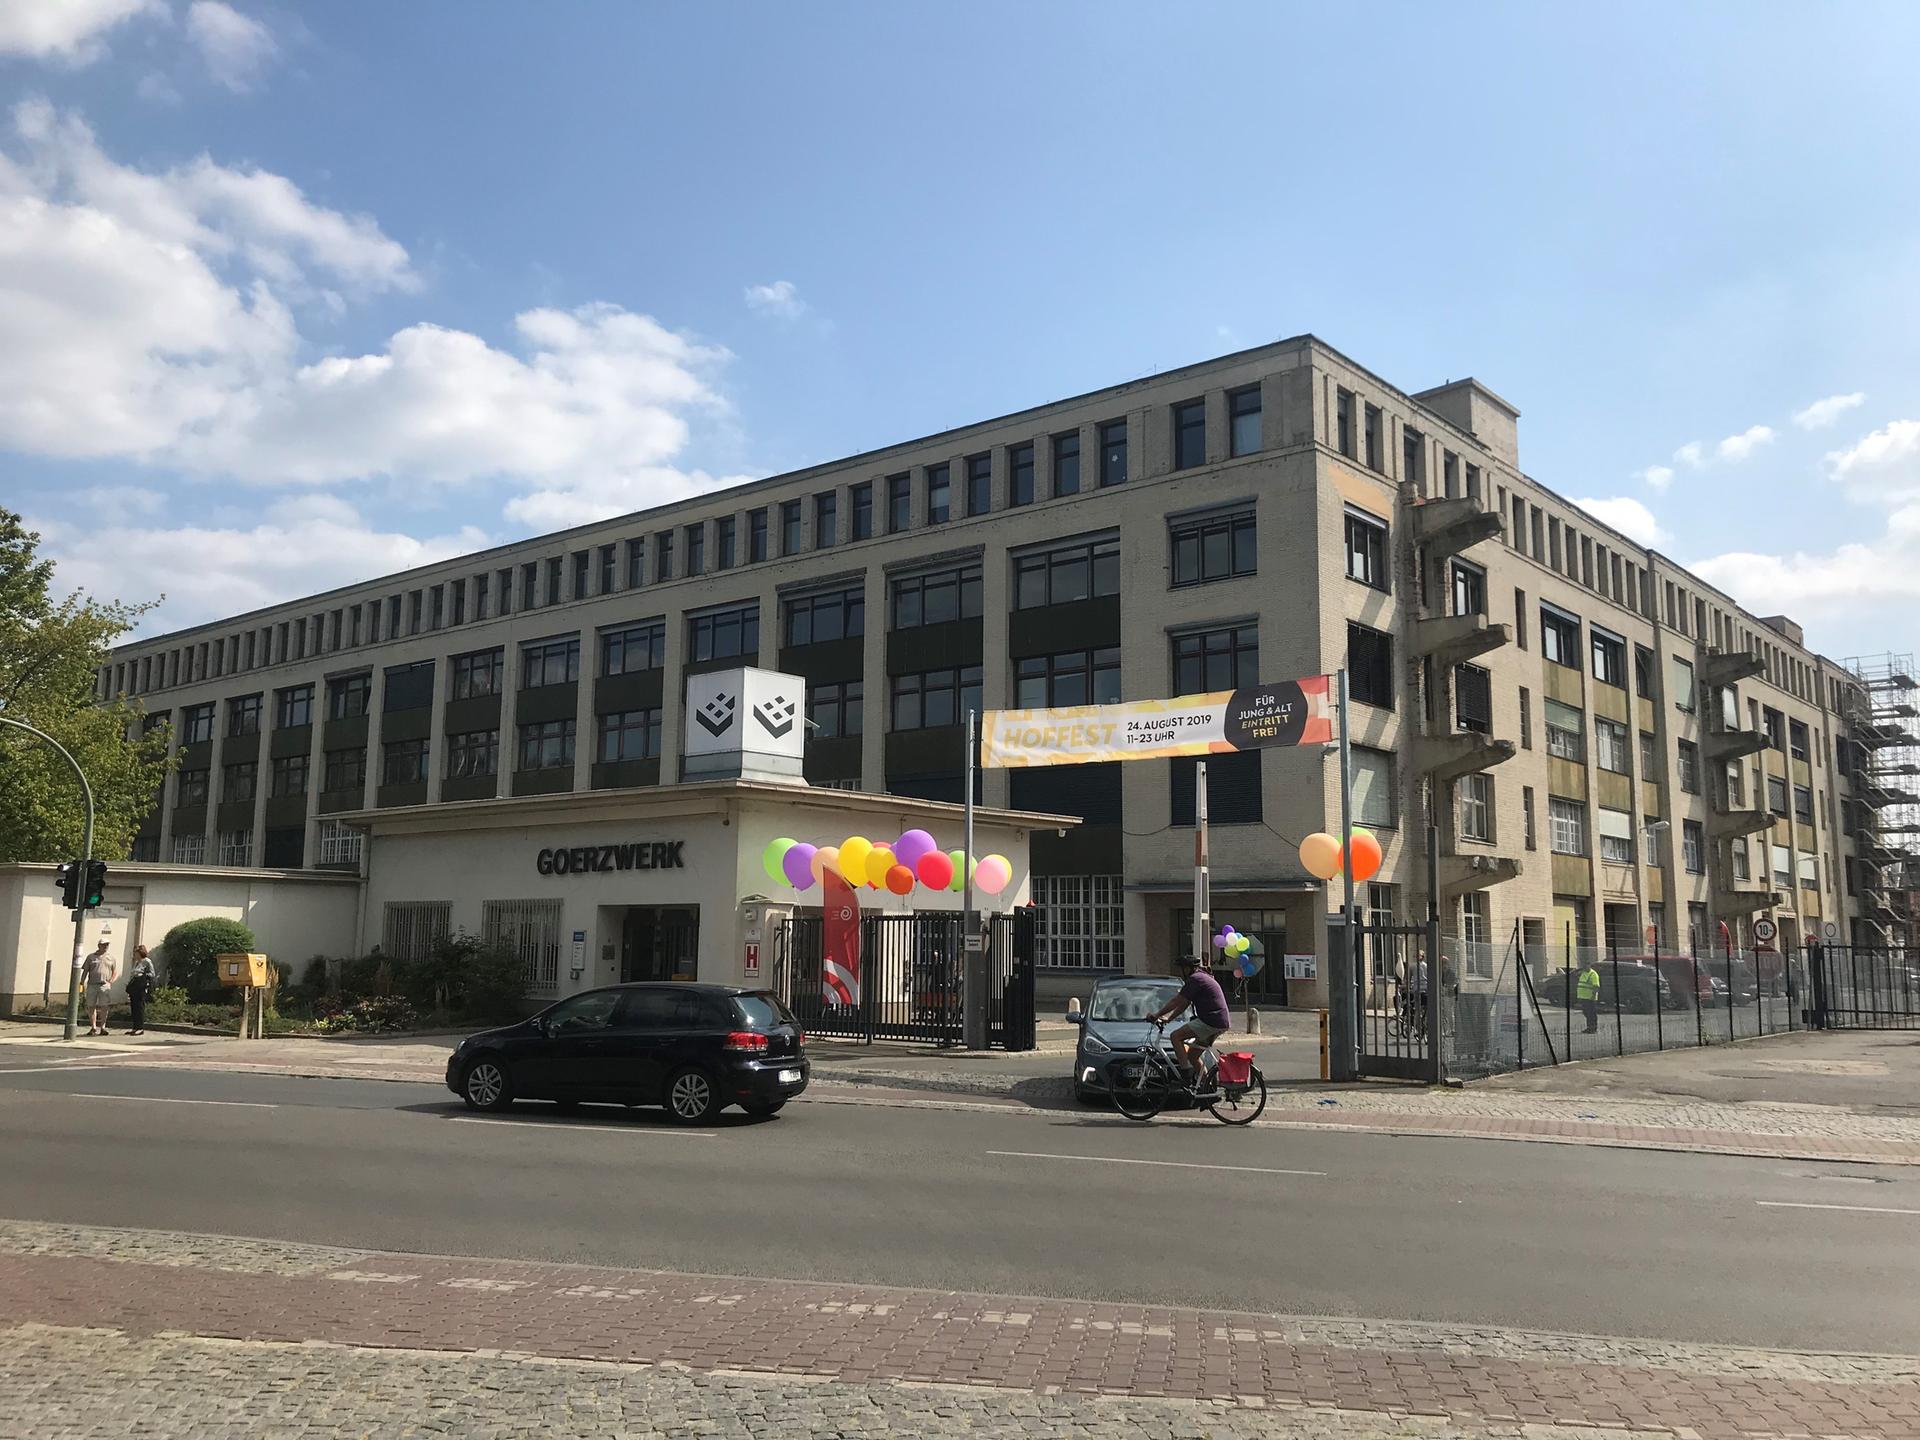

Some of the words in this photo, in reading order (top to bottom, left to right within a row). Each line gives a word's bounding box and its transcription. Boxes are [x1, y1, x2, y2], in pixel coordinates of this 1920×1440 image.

[1255, 694, 1275, 707] FÜR
[1238, 708, 1265, 720] JUNG
[1266, 706, 1274, 715] &
[1274, 702, 1293, 714] ALT
[1127, 721, 1142, 731] 24.
[1143, 717, 1184, 730] AUGUST
[1187, 714, 1212, 726] 2019
[1241, 714, 1289, 729] EINTRITT
[1003, 723, 1117, 748] HOFFEST
[1127, 733, 1153, 744] 11-23
[1154, 730, 1175, 742] UHR
[1252, 727, 1278, 738] FREI
[537, 841, 684, 875] GOERZWERK
[1759, 925, 1768, 935] 10
[746, 945, 758, 969] H
